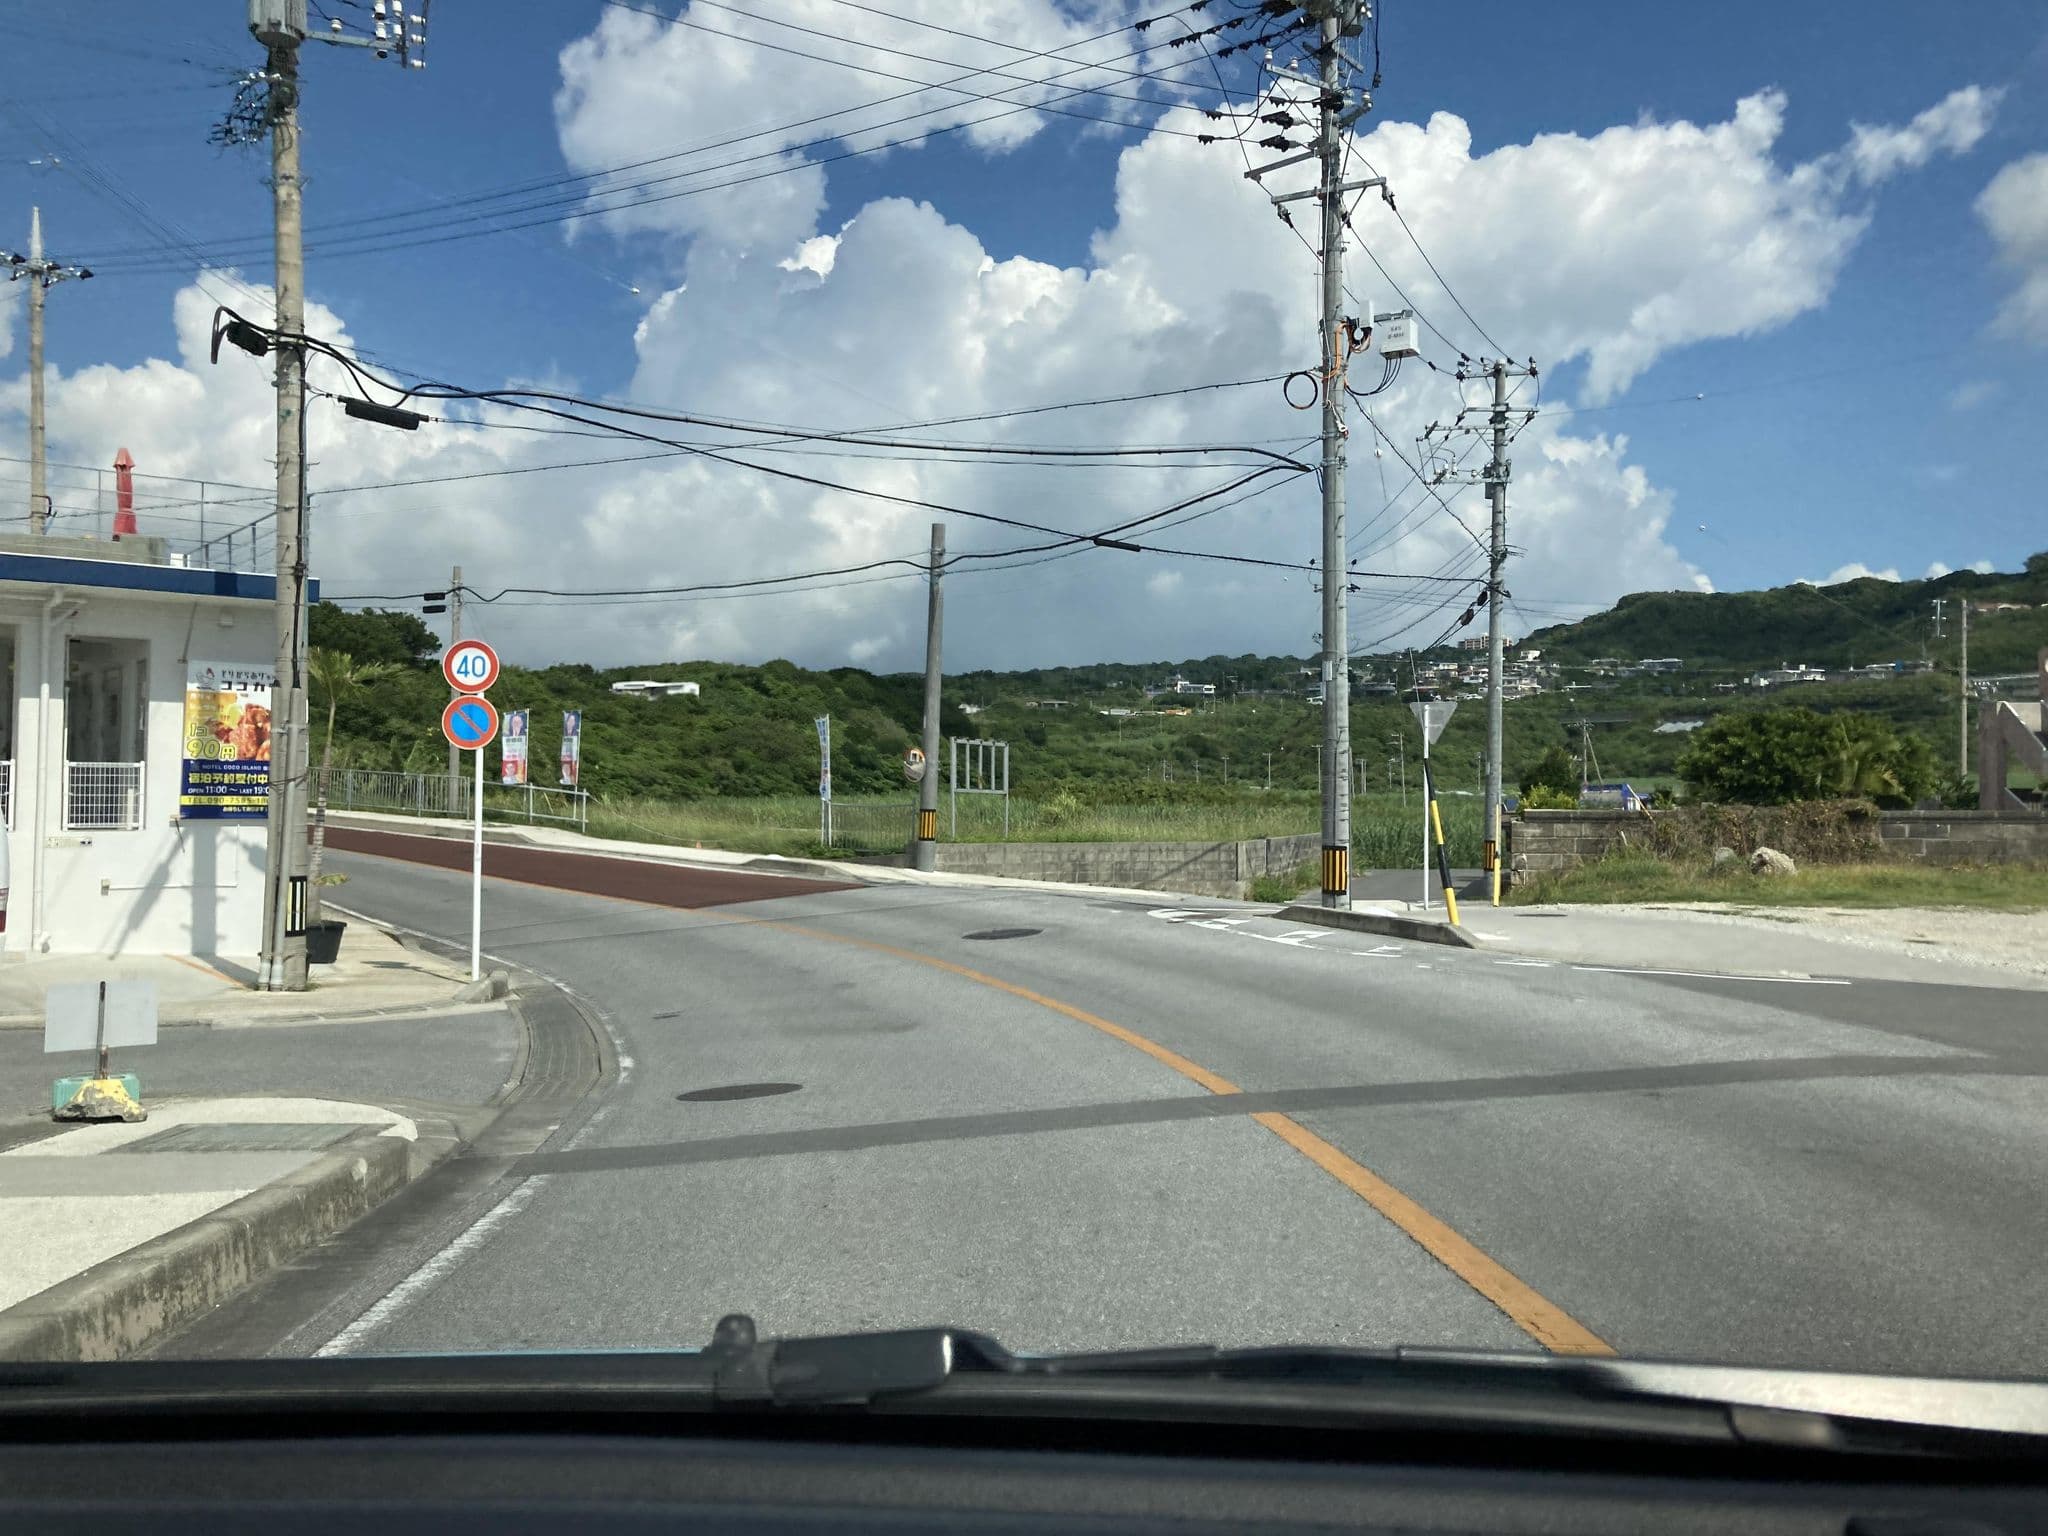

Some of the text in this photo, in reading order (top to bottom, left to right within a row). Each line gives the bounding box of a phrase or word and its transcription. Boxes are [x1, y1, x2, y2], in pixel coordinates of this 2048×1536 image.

[457, 655, 486, 678] 40
[186, 738, 236, 760] 90円
[206, 785, 227, 793] 11:00
